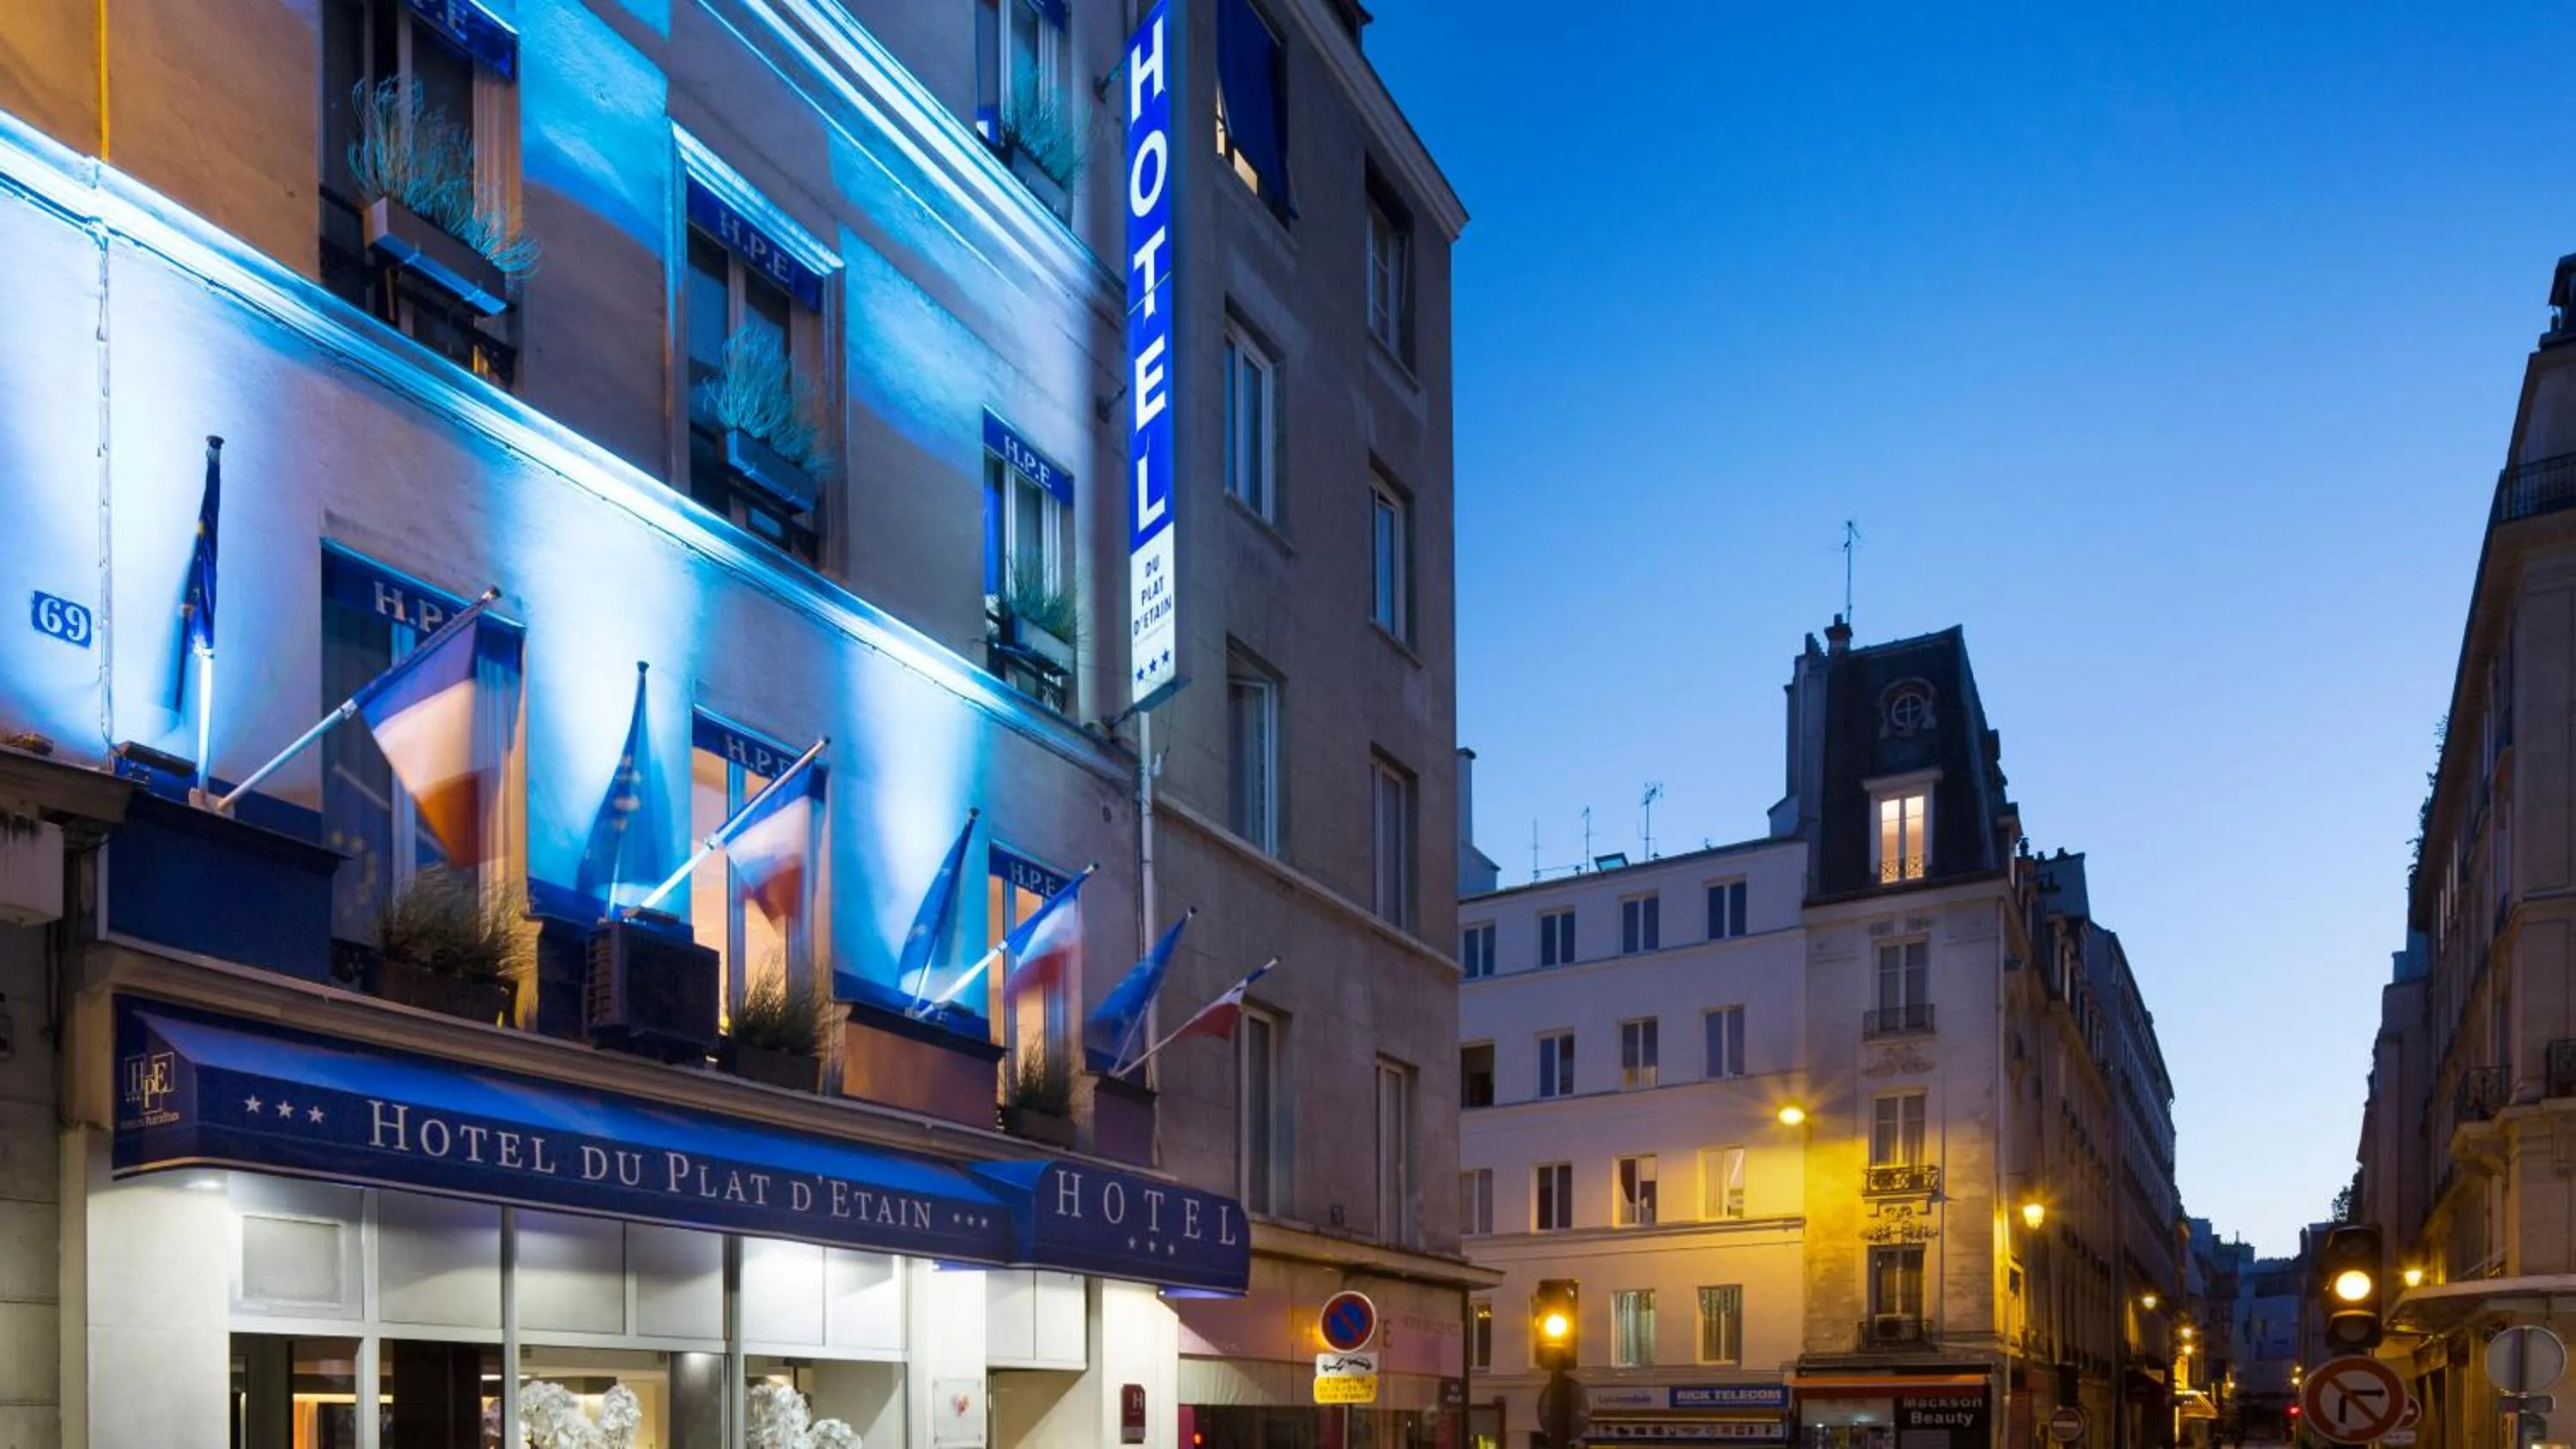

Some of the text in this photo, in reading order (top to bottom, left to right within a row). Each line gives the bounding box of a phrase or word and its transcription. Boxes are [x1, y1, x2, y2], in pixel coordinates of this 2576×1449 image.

[1130, 15, 1168, 533] HOTEL
[1004, 434, 1051, 489] H.P.E
[1145, 555, 1160, 577] DU
[1141, 576, 1164, 605] PLAT
[39, 598, 88, 641] 69
[1133, 594, 1172, 635] D'ETAIN
[367, 1100, 932, 1230] HOTEL DU PLAT D'ETAIN
[1055, 1169, 1236, 1246] HOTEL
[1133, 1391, 1144, 1410] H
[1715, 1388, 1783, 1401] TELECOM
[1911, 1411, 1974, 1428] Beauty
